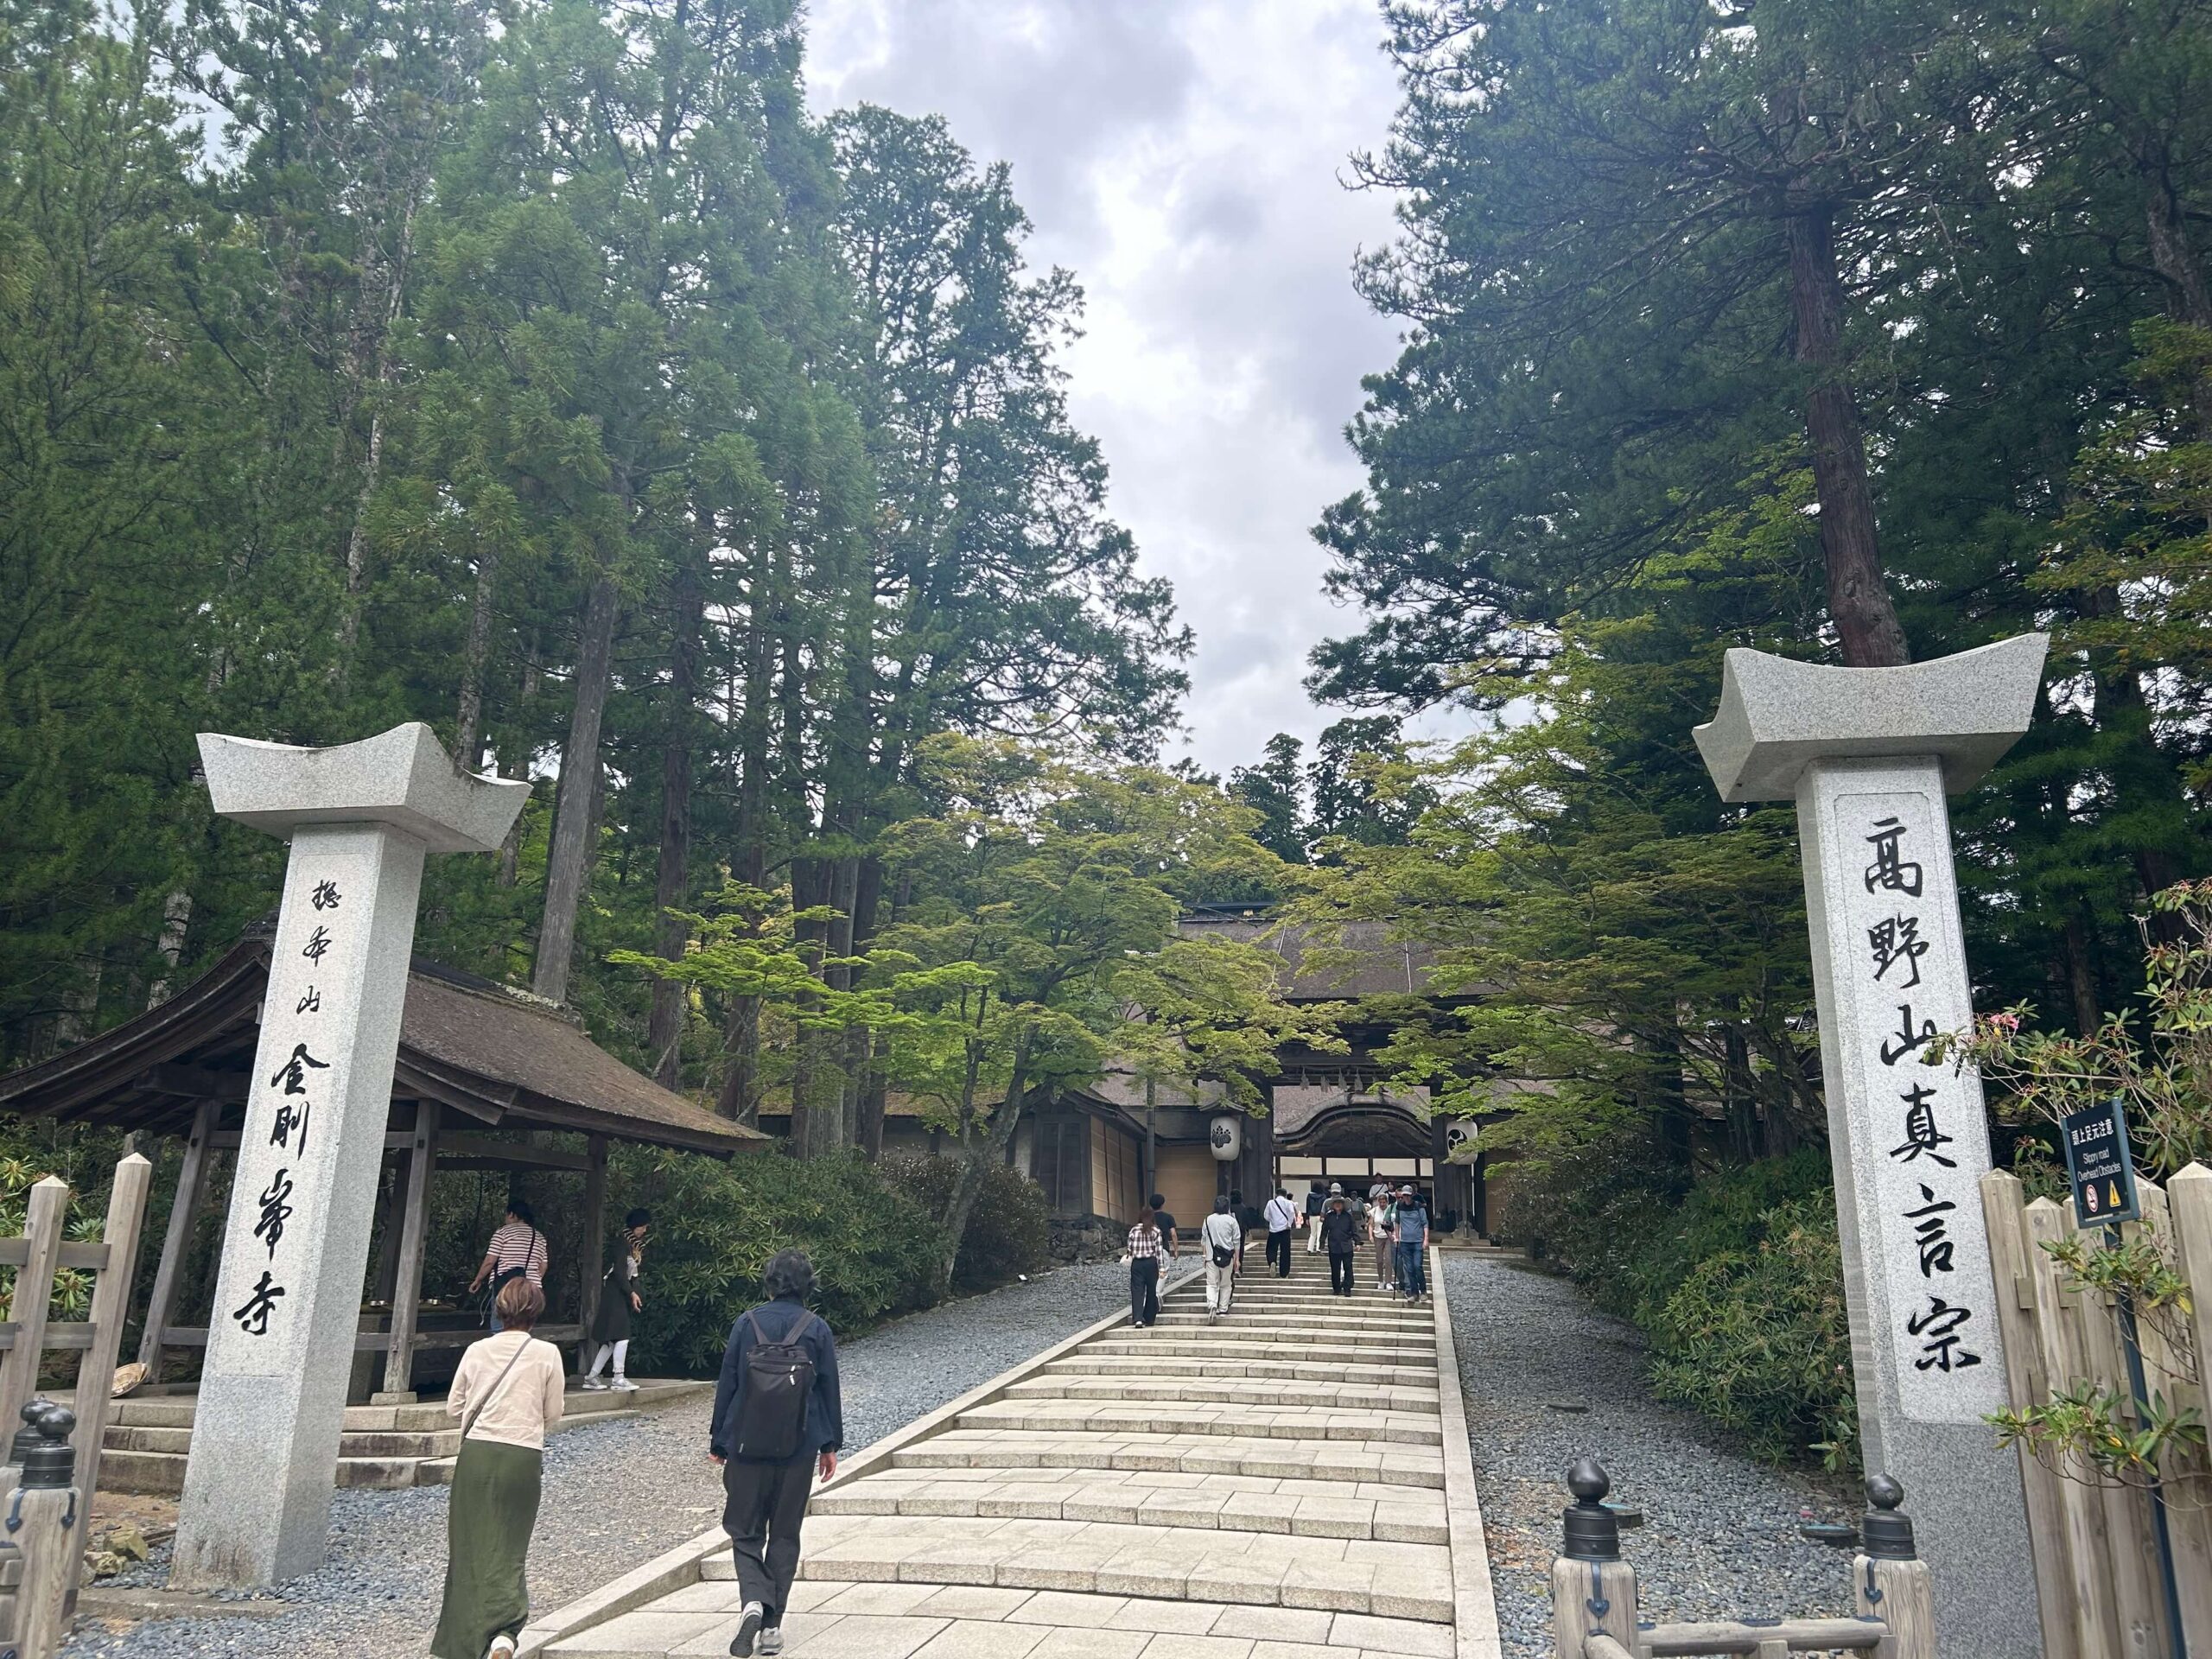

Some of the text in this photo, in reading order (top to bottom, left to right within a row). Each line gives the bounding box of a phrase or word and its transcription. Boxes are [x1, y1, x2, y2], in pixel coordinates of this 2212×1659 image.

[1864, 817, 1981, 1374] 高野山真言宗
[2070, 1118, 2113, 1146] 頭上足元注意
[2098, 1147, 2109, 1160] road
[2077, 1161, 2121, 1182] Overhead Obstacles
